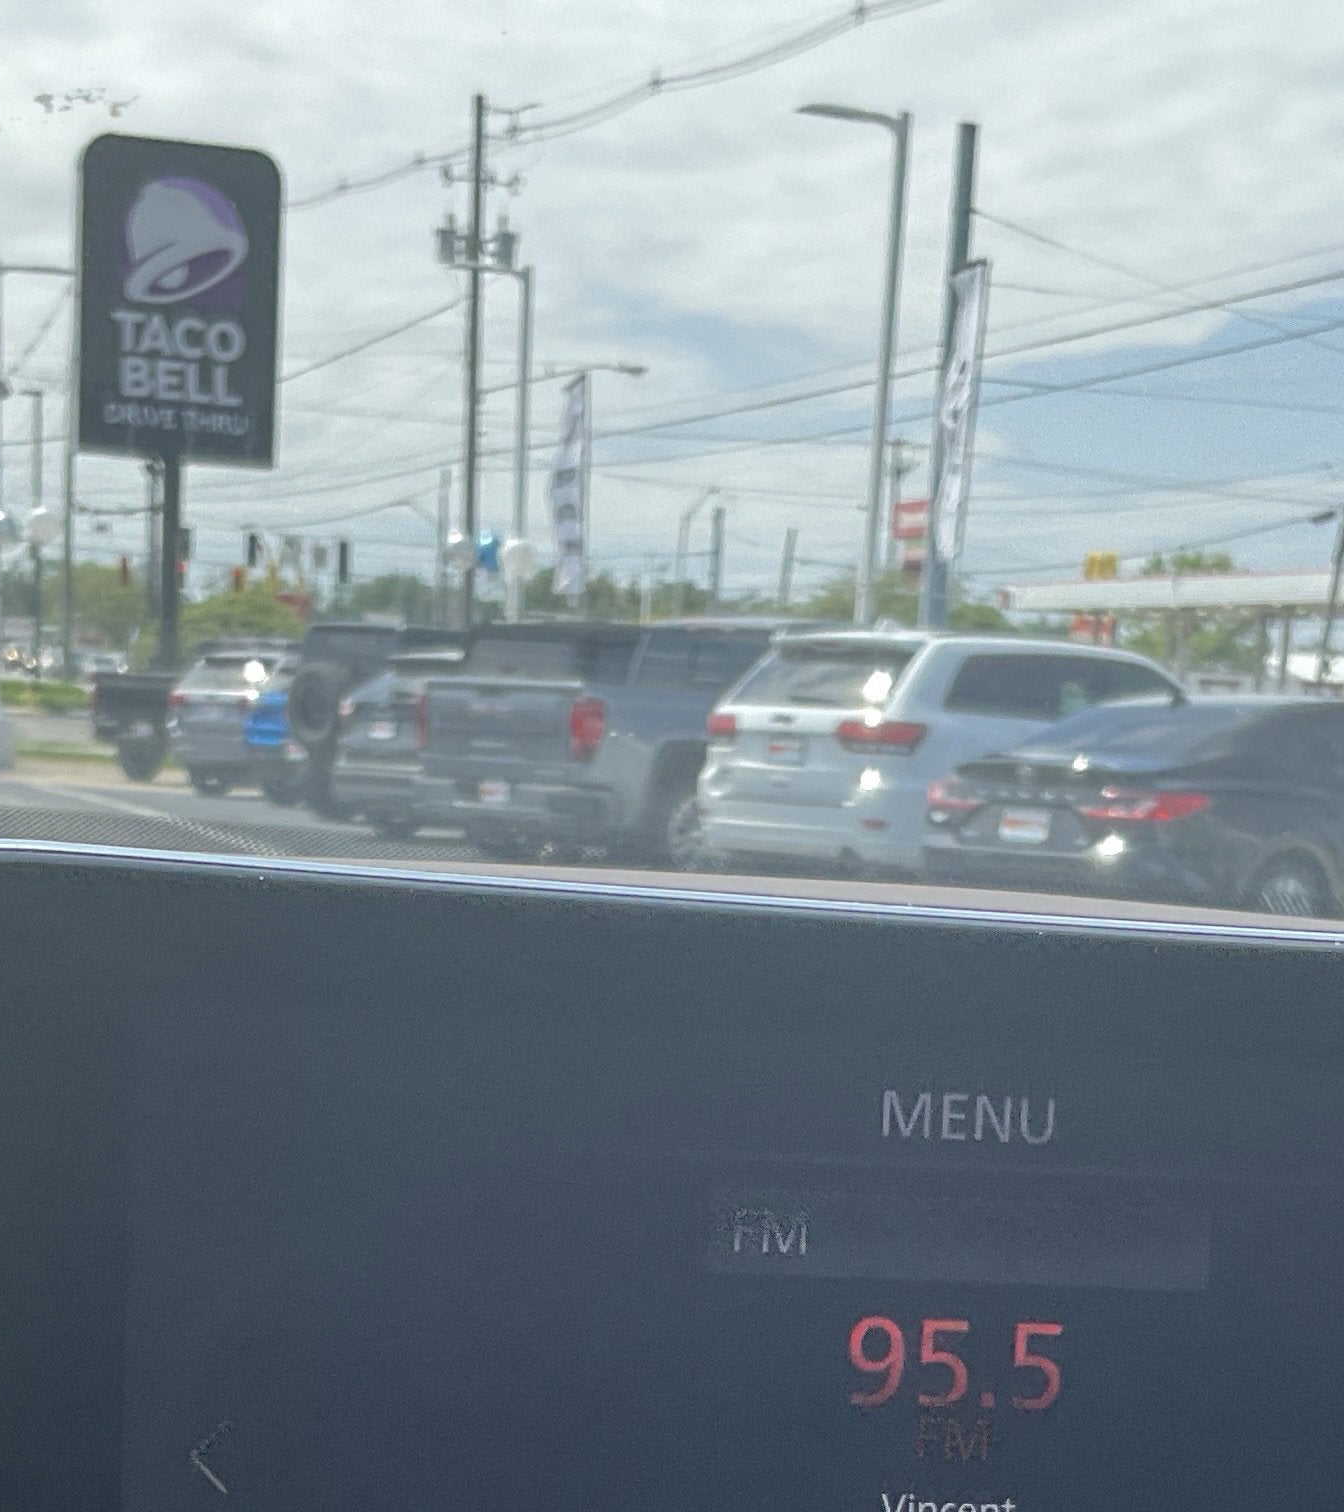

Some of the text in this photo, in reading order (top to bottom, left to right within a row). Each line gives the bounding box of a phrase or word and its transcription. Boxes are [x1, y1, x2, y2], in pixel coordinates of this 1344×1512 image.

[110, 309, 246, 363] TACO
[120, 356, 243, 406] BELL
[881, 1089, 1056, 1144] MENU
[731, 1208, 810, 1256] FM
[848, 1315, 1064, 1411] 95.5
